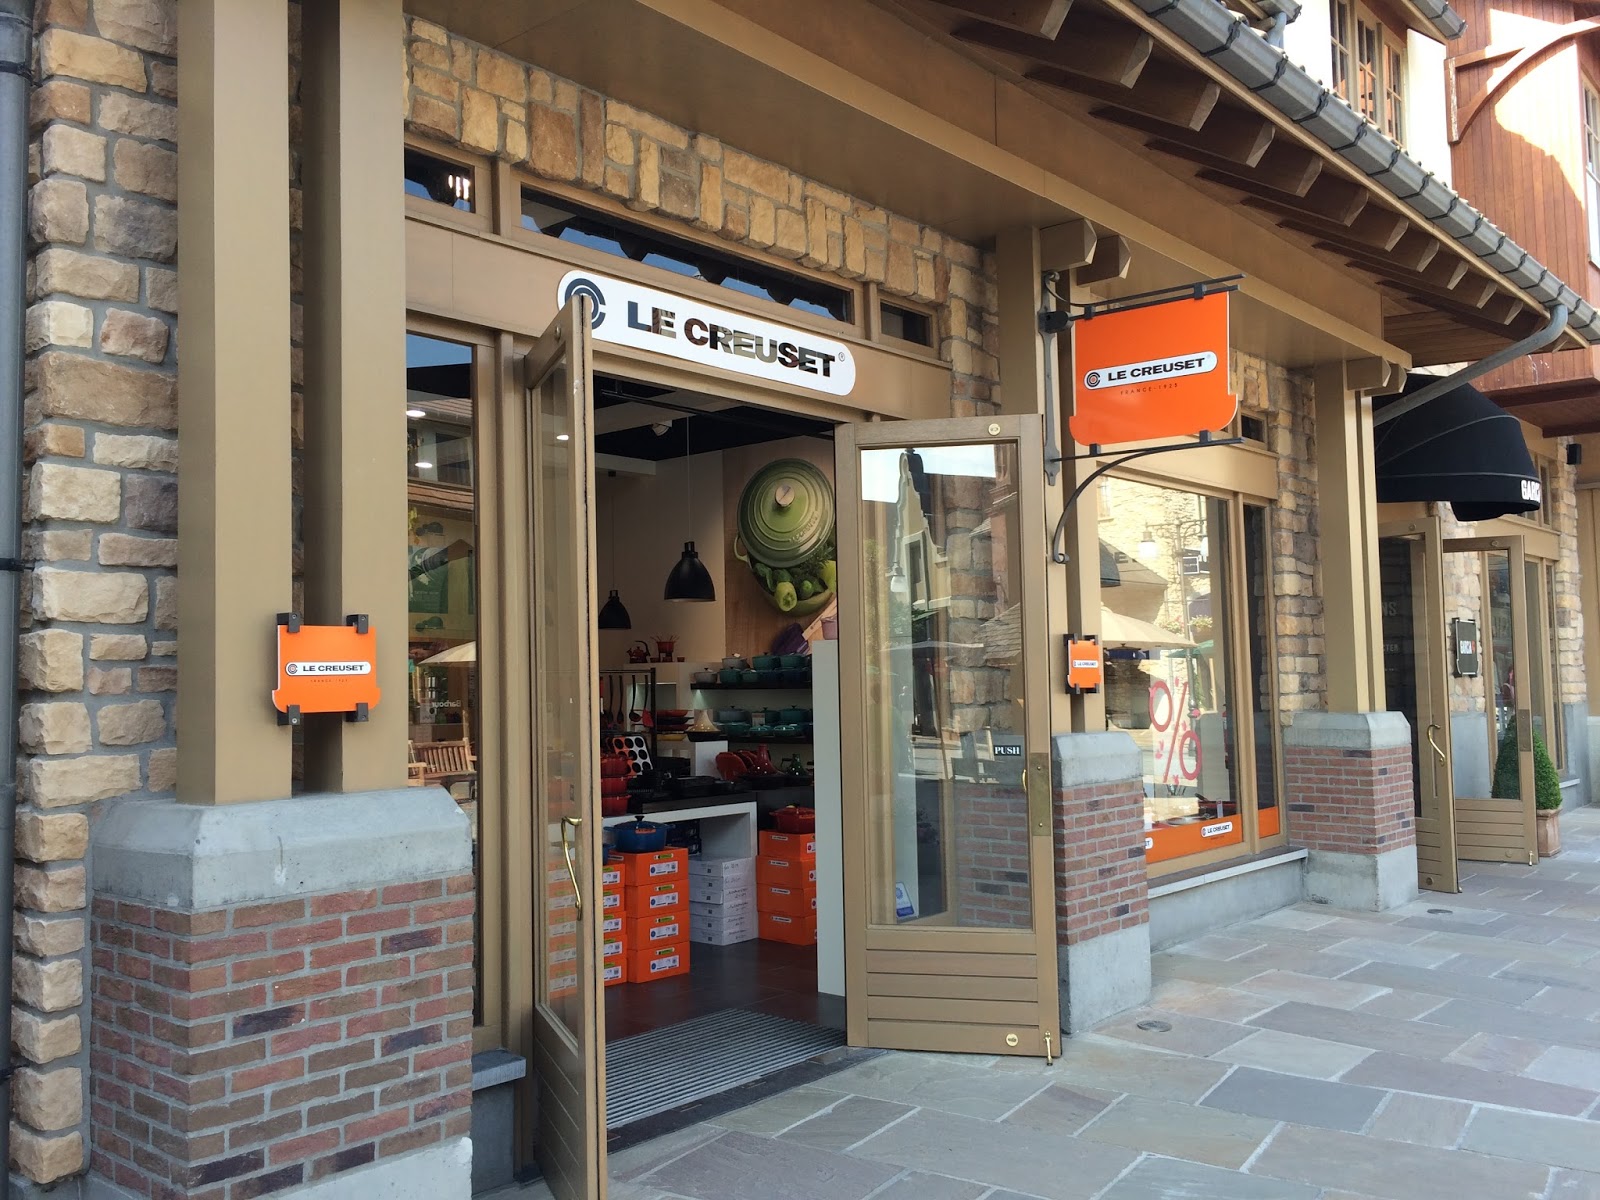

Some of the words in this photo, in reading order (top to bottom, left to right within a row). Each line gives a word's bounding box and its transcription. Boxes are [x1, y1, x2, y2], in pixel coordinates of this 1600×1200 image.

[627, 301, 676, 339] LE
[684, 318, 835, 377] CREUSET
[1108, 370, 1127, 382] LE
[1130, 357, 1205, 378] CREUSET
[318, 664, 364, 672] CREUSET
[994, 746, 1020, 755] PUSH
